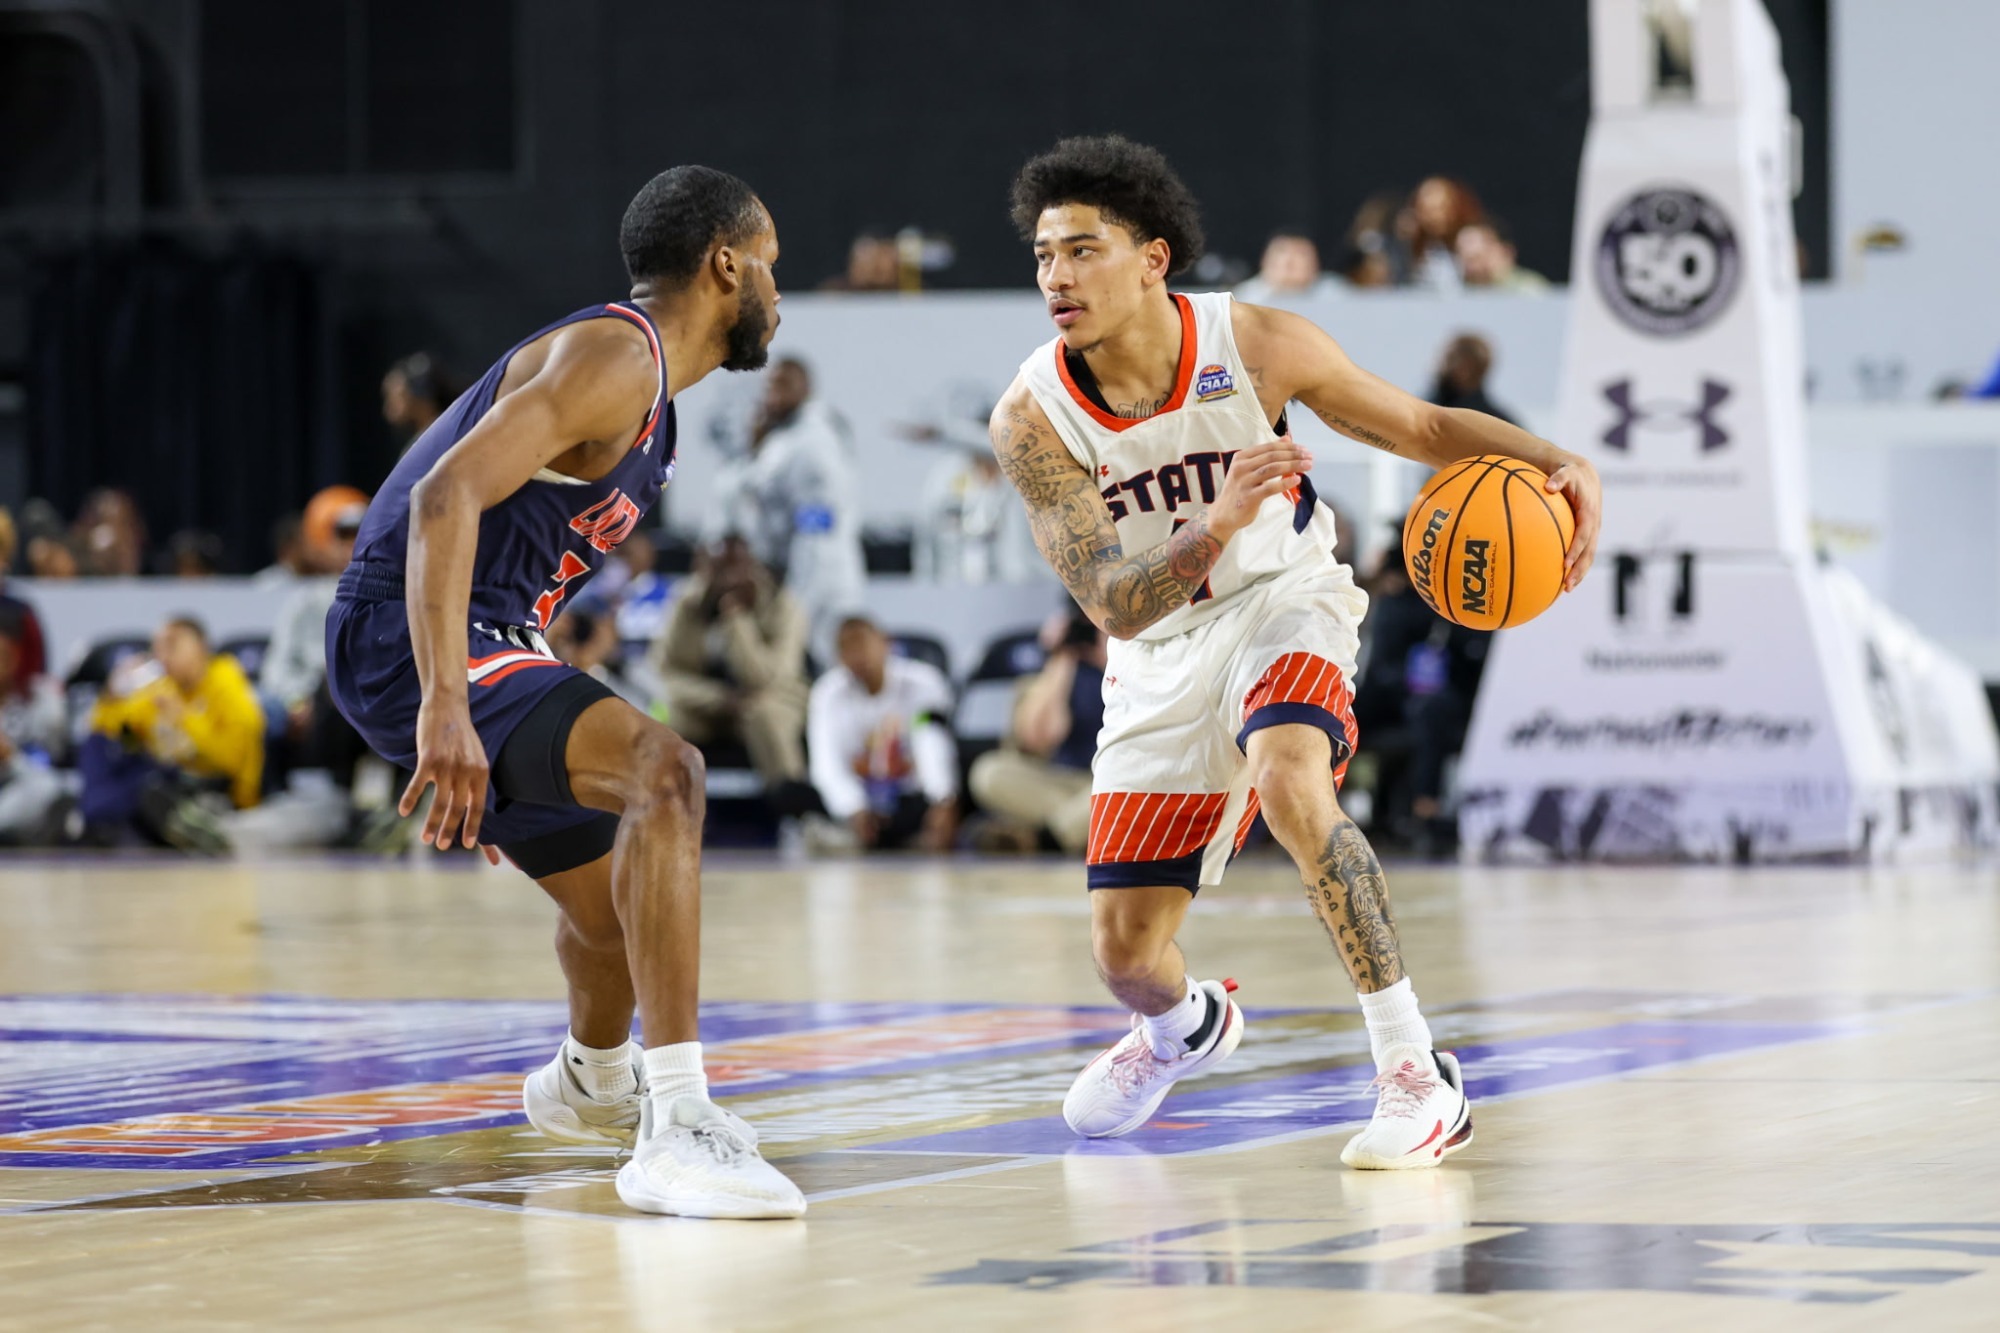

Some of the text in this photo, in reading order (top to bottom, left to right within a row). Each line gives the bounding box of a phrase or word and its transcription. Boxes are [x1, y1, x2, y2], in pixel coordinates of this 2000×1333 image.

[1197, 375, 1232, 395] CIAA
[1101, 449, 1243, 525] STAT
[1412, 508, 1449, 611] Wilson
[1462, 540, 1489, 615] NCAA
[1319, 878, 1338, 912] GOD
